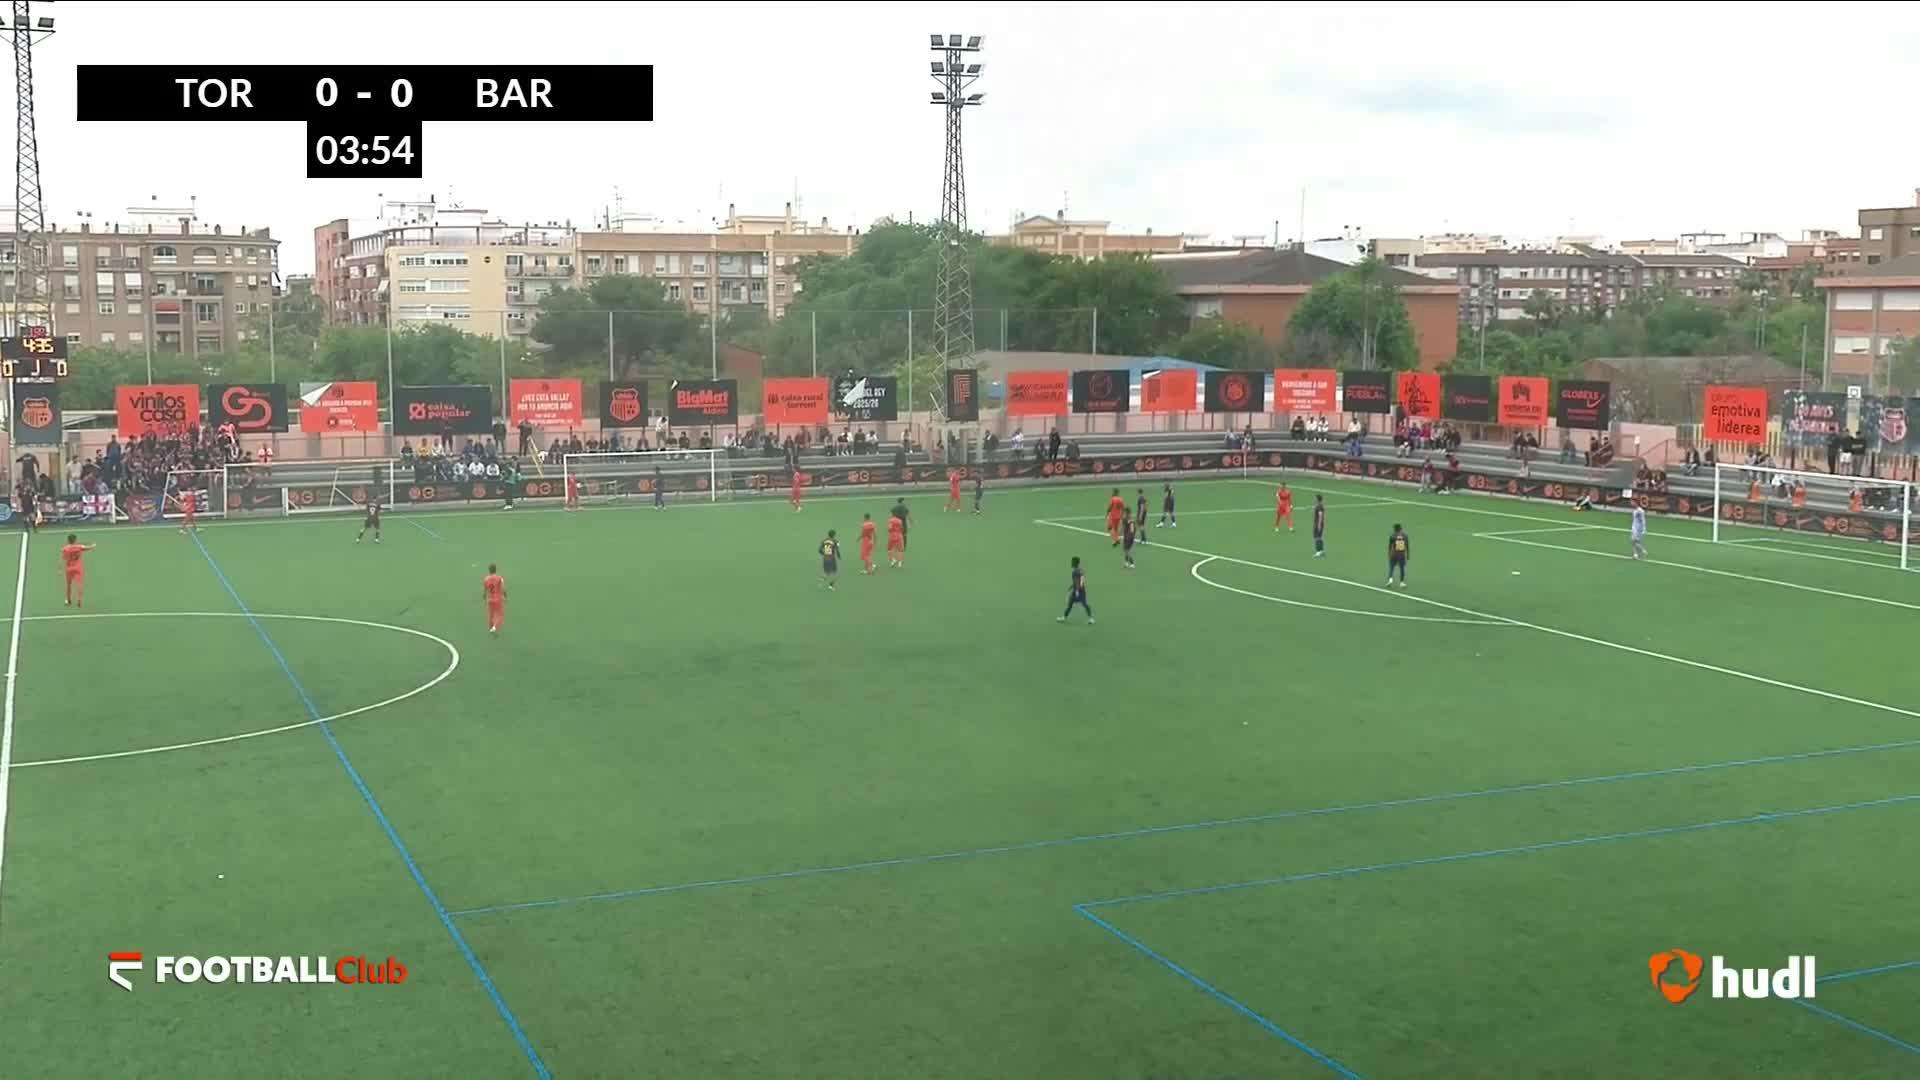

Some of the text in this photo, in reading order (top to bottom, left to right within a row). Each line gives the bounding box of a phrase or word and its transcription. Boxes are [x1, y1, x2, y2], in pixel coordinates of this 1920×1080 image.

[130, 392, 185, 409] vinilos
[677, 390, 728, 405] BigMat
[140, 409, 186, 423] casa
[1711, 404, 1760, 417] emotiva
[1717, 419, 1760, 435] liderea
